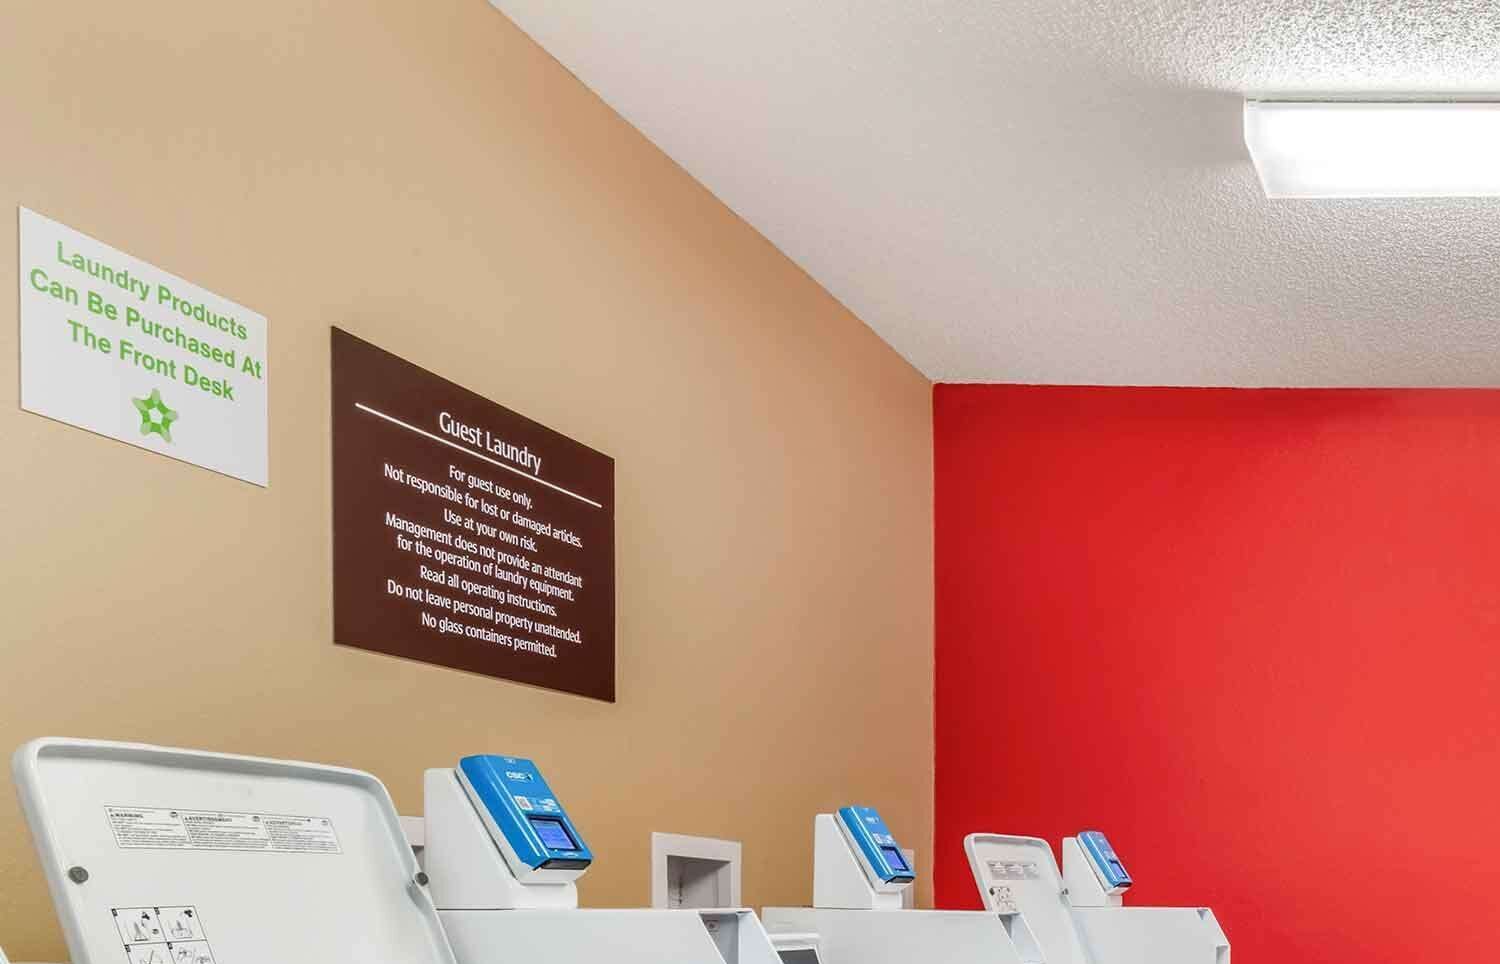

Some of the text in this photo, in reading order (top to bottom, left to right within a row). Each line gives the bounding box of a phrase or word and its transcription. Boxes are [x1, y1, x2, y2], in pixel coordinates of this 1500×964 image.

[30, 268, 262, 379] Can Be Purchased At
[57, 241, 248, 340] Laundry Products
[68, 320, 234, 401] The Front Desk
[439, 412, 542, 474] Guest Laundry
[385, 462, 583, 548] Not responsible for lost or damaged articles.
[449, 464, 533, 511] For guest use only.
[385, 511, 583, 589] Management does not provide an attendant
[444, 507, 538, 553] Use at your own risk.
[397, 533, 575, 602] for the operation of laundry equipment.
[420, 564, 558, 617] Read all operating instructions.
[387, 578, 582, 644] Do not leave personal property unattended.
[422, 611, 557, 658] No glass containers permitted.
